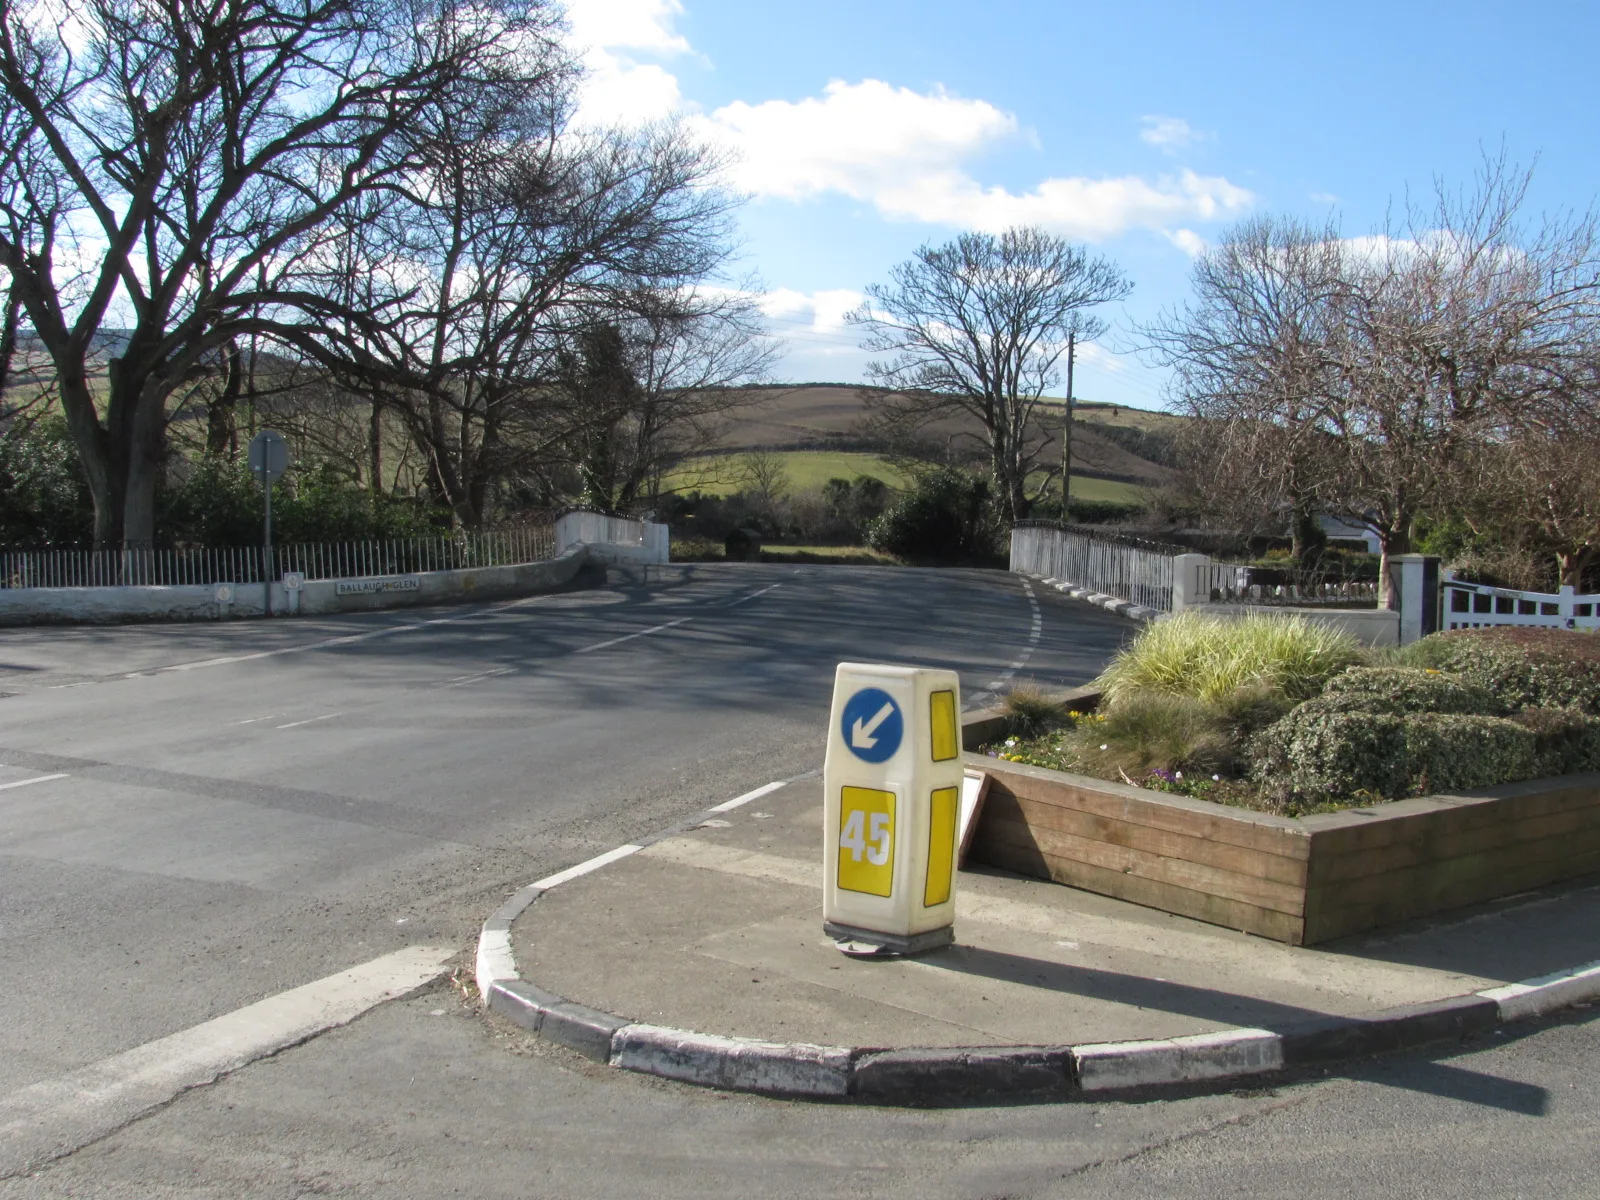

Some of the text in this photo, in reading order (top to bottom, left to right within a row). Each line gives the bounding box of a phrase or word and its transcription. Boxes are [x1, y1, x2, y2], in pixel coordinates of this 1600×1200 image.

[340, 580, 416, 592] BALLAUGH GLEN
[840, 809, 890, 866] 45
